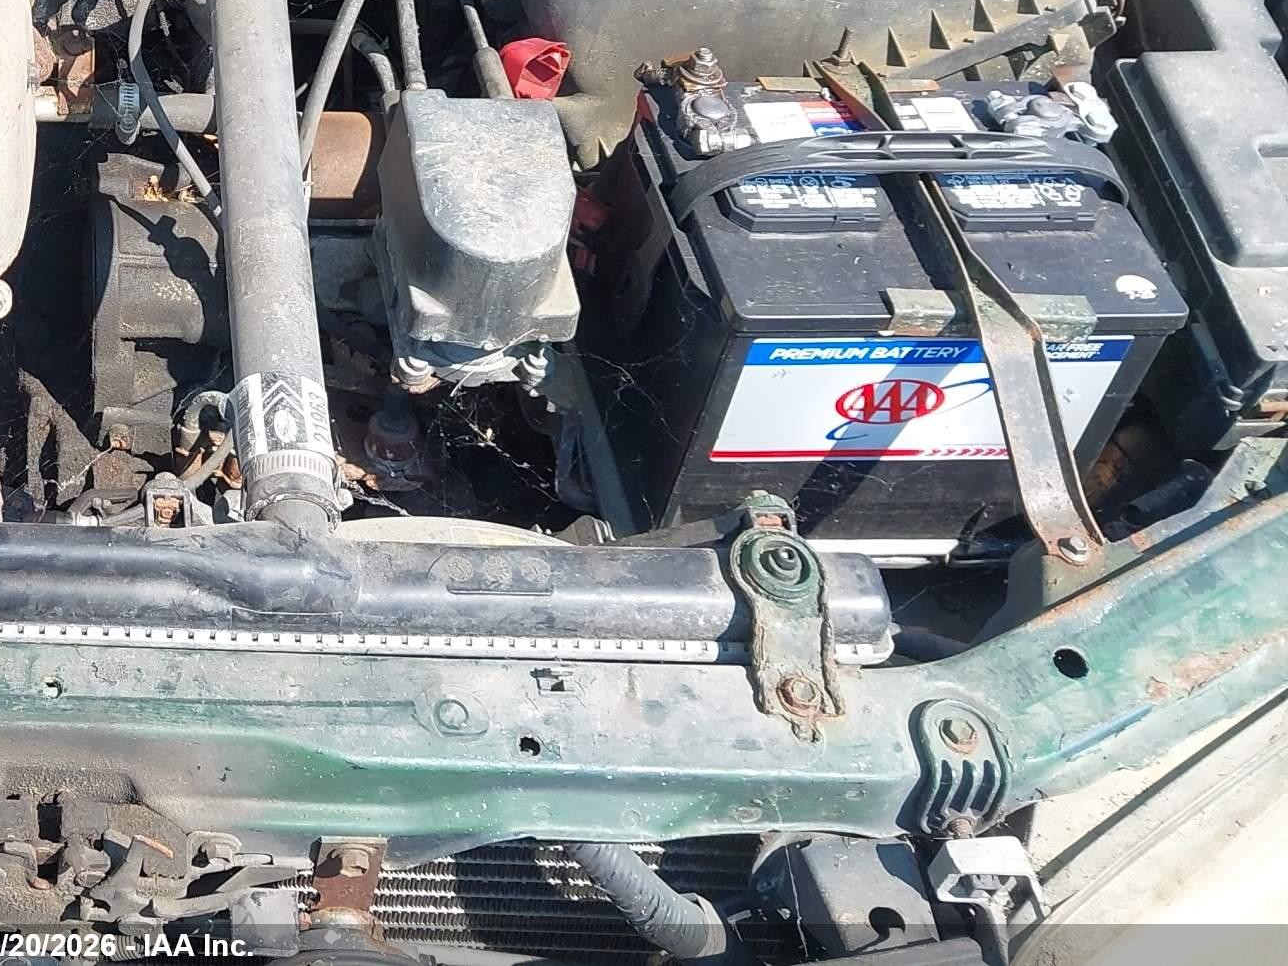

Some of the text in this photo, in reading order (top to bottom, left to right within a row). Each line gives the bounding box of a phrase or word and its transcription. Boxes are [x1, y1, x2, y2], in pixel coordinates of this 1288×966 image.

[769, 346, 968, 361] PREMIUM BATTERY
[1065, 342, 1105, 352] FREE
[842, 379, 939, 424] AAA
[308, 391, 331, 444] 21963
